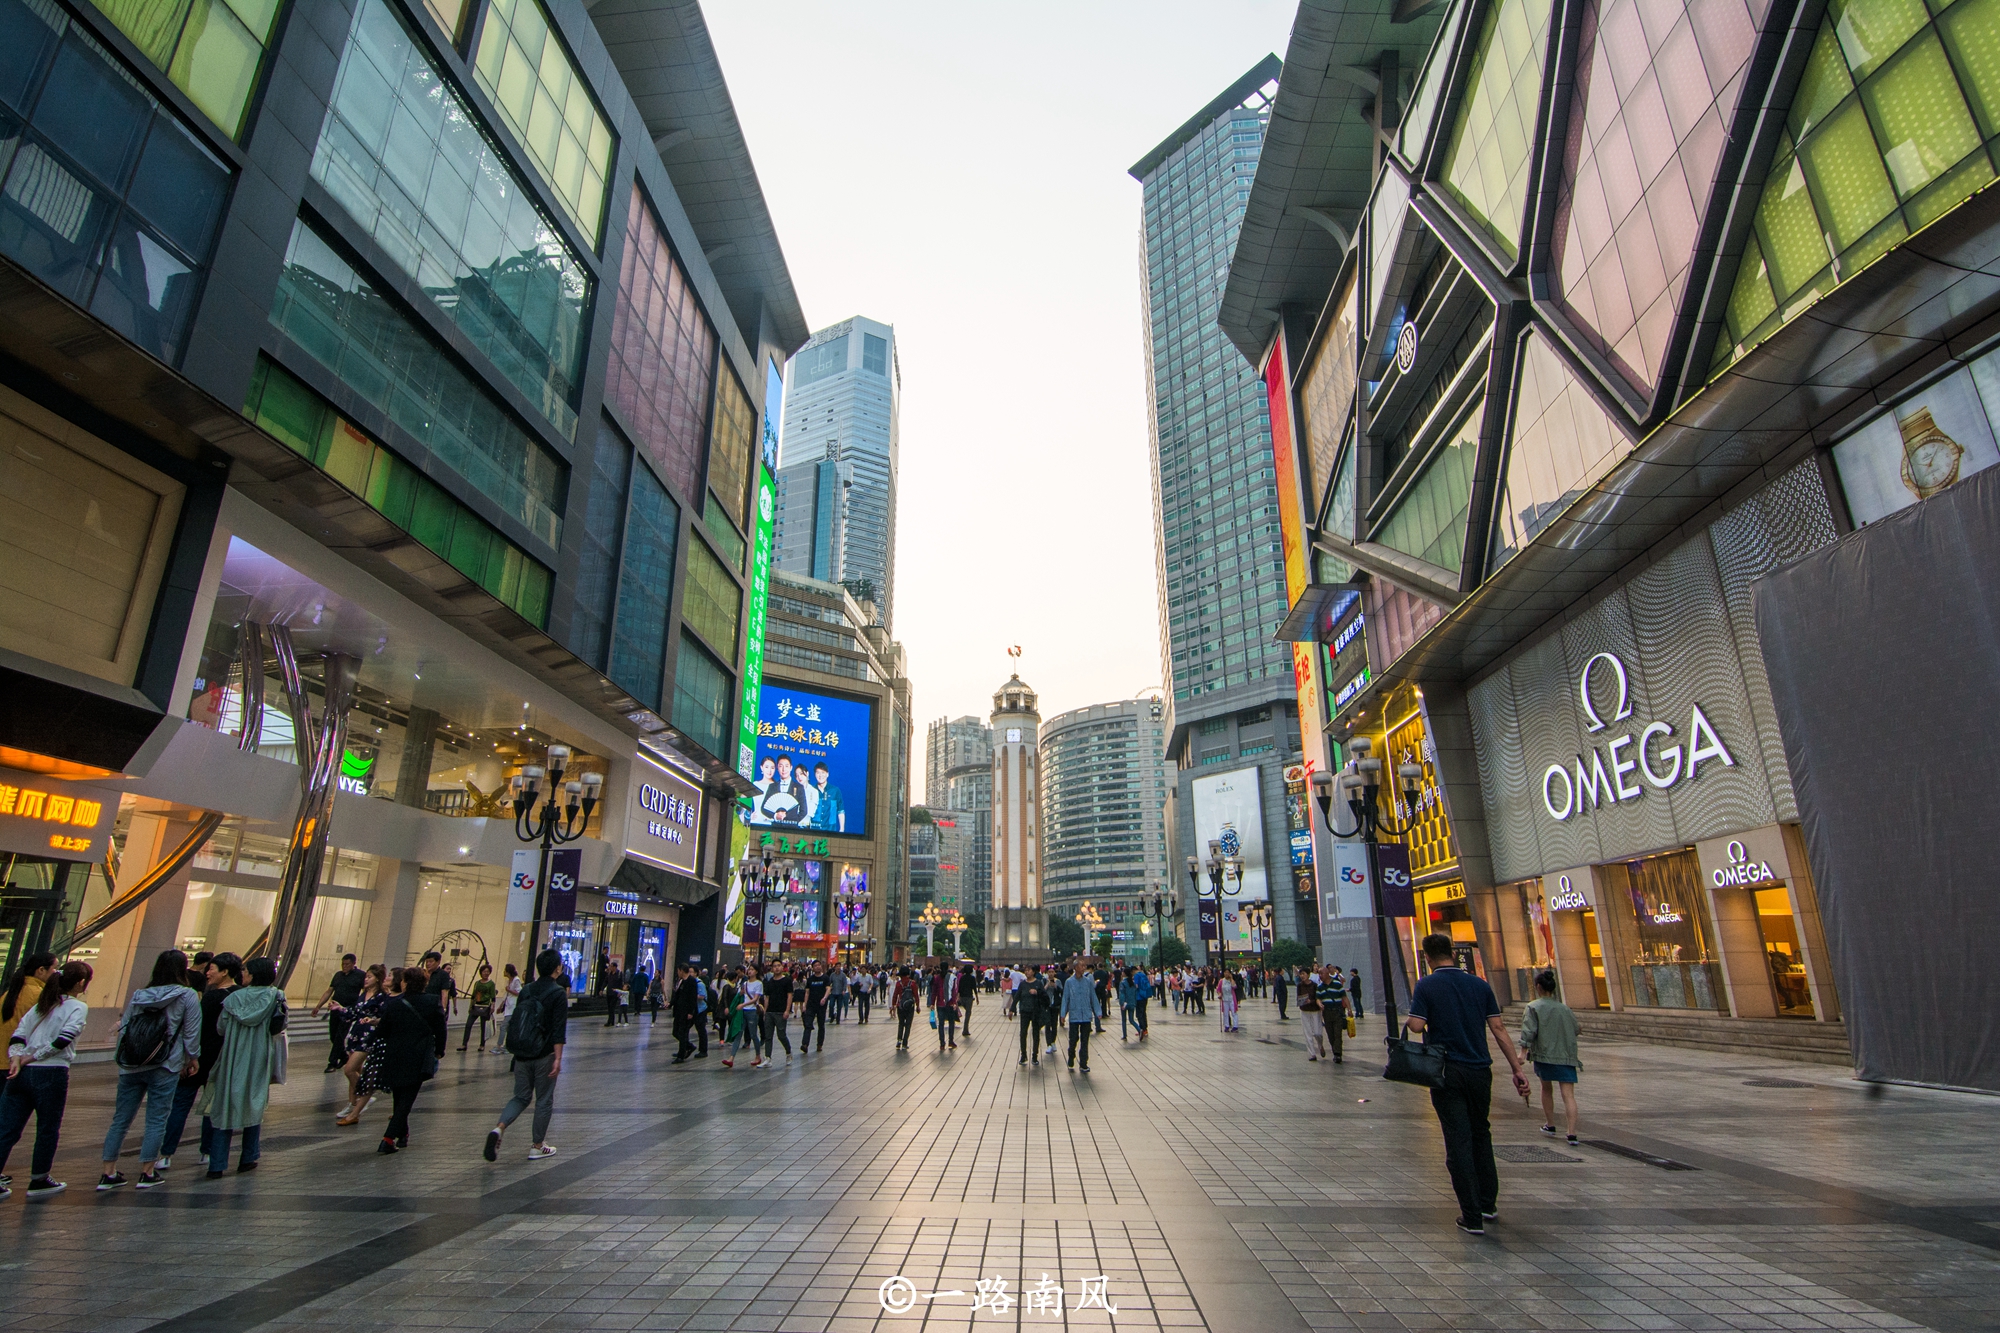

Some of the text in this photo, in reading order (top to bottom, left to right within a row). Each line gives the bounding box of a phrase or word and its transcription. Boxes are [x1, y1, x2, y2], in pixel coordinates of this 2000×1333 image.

[776, 698, 821, 722] 梦之蓝
[757, 720, 839, 748] 经典咏流传
[1543, 702, 1736, 820] OMEGA
[50, 834, 92, 852] 请上3F
[513, 873, 535, 890] 5G
[551, 873, 575, 891] 5G
[1341, 867, 1365, 884] 5G
[1383, 867, 1410, 887] 5G
[1713, 861, 1774, 887] OMEGA
[1551, 892, 1587, 911] OMEGA
[745, 915, 759, 926] 5G
[769, 914, 781, 925] 5G
[1201, 912, 1215, 923] 5G
[1224, 912, 1237, 922] 5G
[1654, 913, 1682, 923] OMEGA
